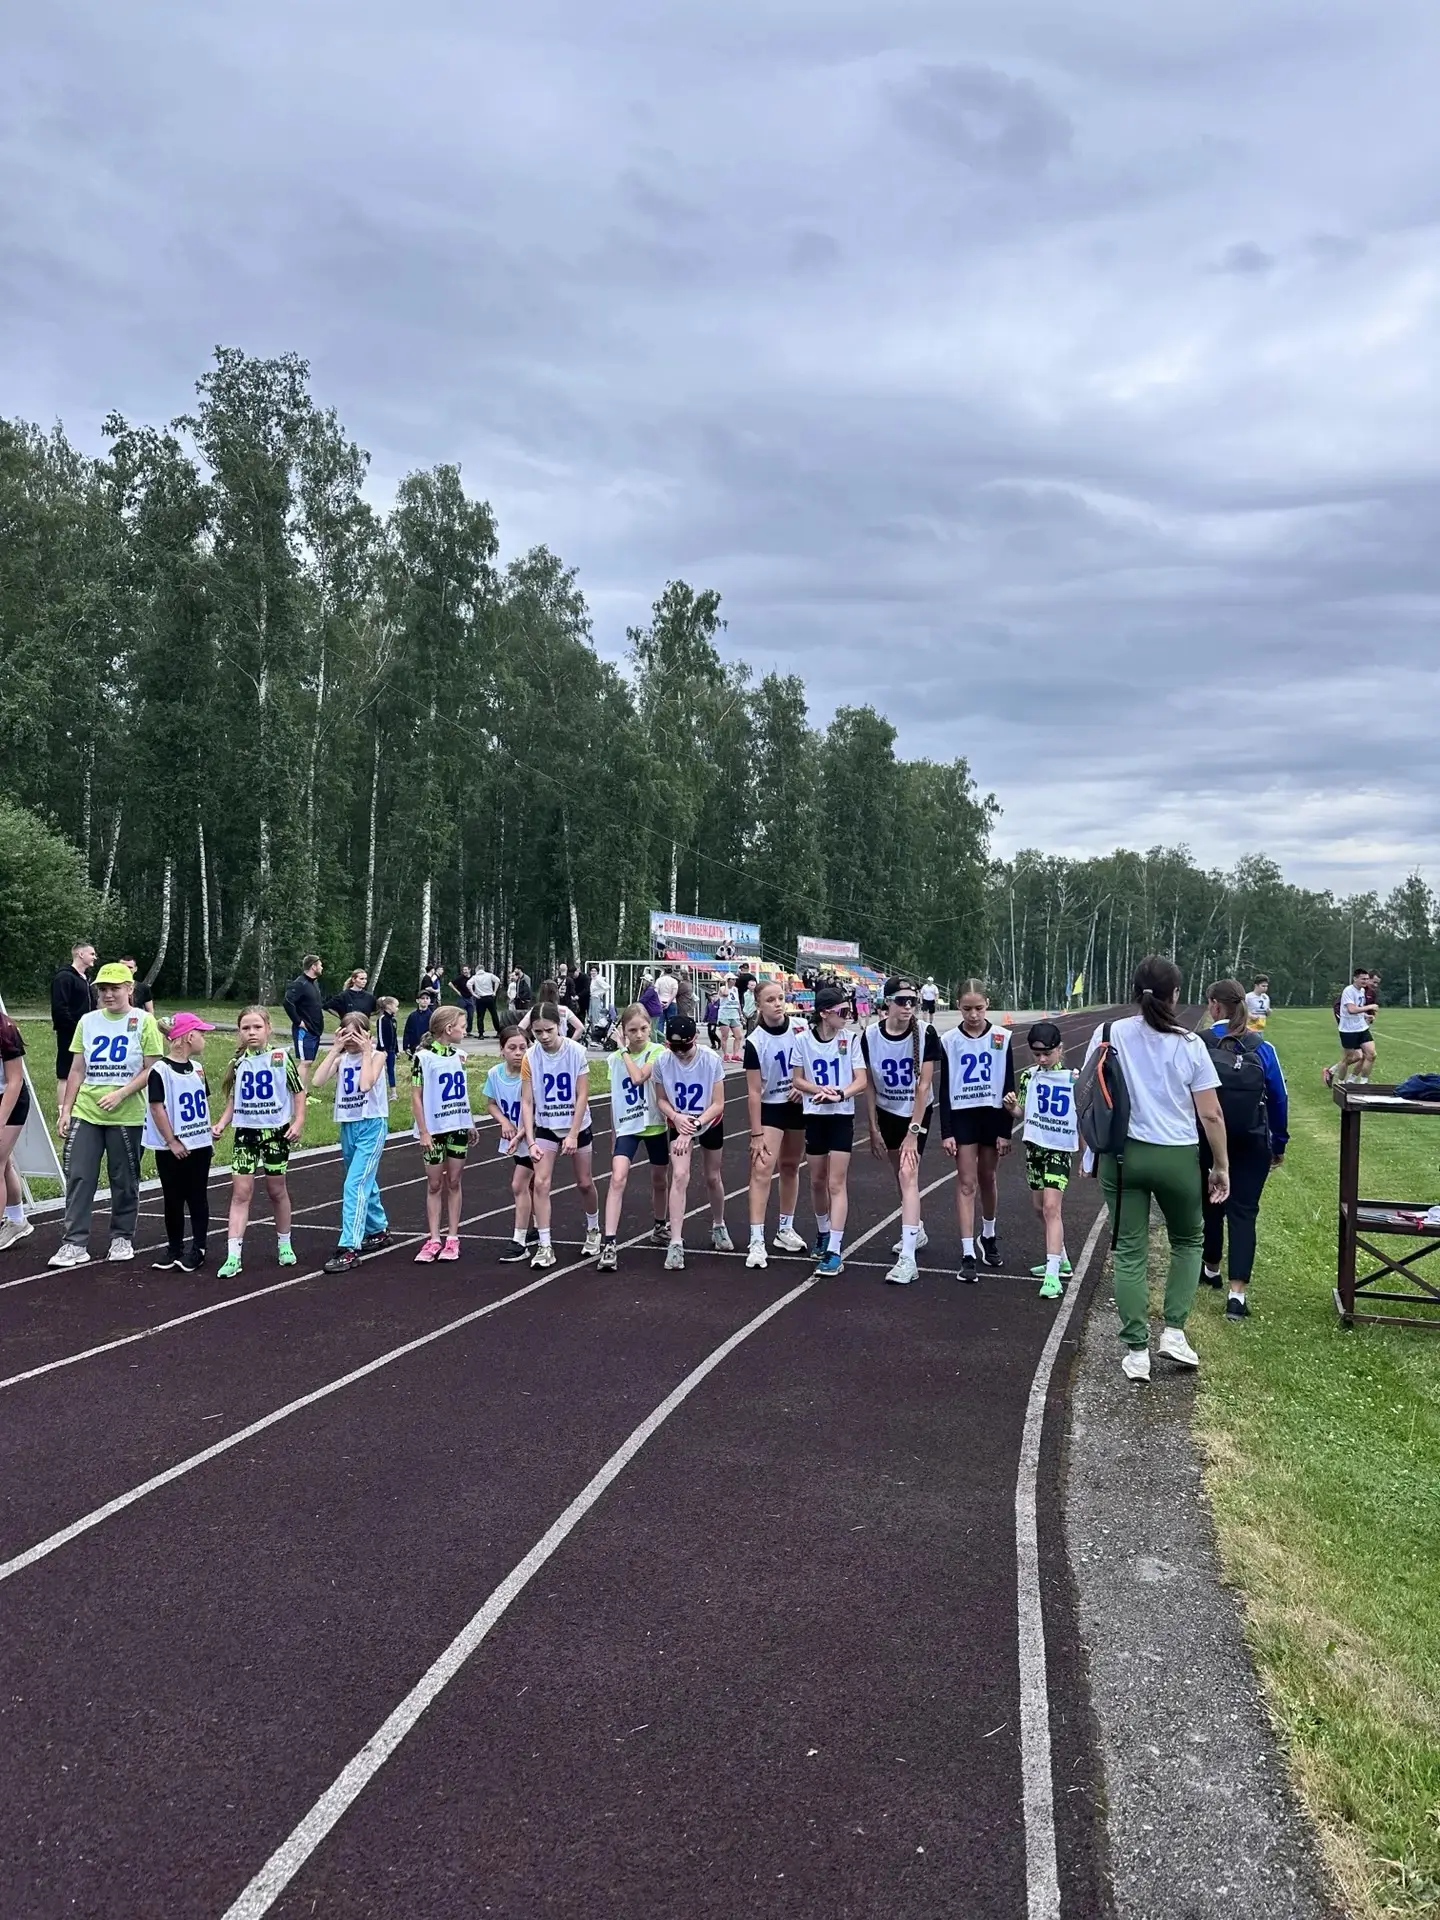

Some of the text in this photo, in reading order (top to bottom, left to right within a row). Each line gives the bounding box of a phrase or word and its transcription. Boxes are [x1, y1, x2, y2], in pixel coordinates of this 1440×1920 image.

[664, 918, 685, 935] ВРЕМЯ
[1259, 1000, 1265, 1009] 2
[90, 1035, 129, 1063] 26
[812, 1058, 840, 1087] 31
[881, 1057, 914, 1087] 33
[960, 1052, 992, 1084] 23
[241, 1069, 274, 1101] 38
[438, 1070, 466, 1102] 28
[543, 1072, 572, 1102] 29
[674, 1082, 704, 1111] 32
[1036, 1083, 1072, 1117] 35
[179, 1089, 207, 1122] 36
